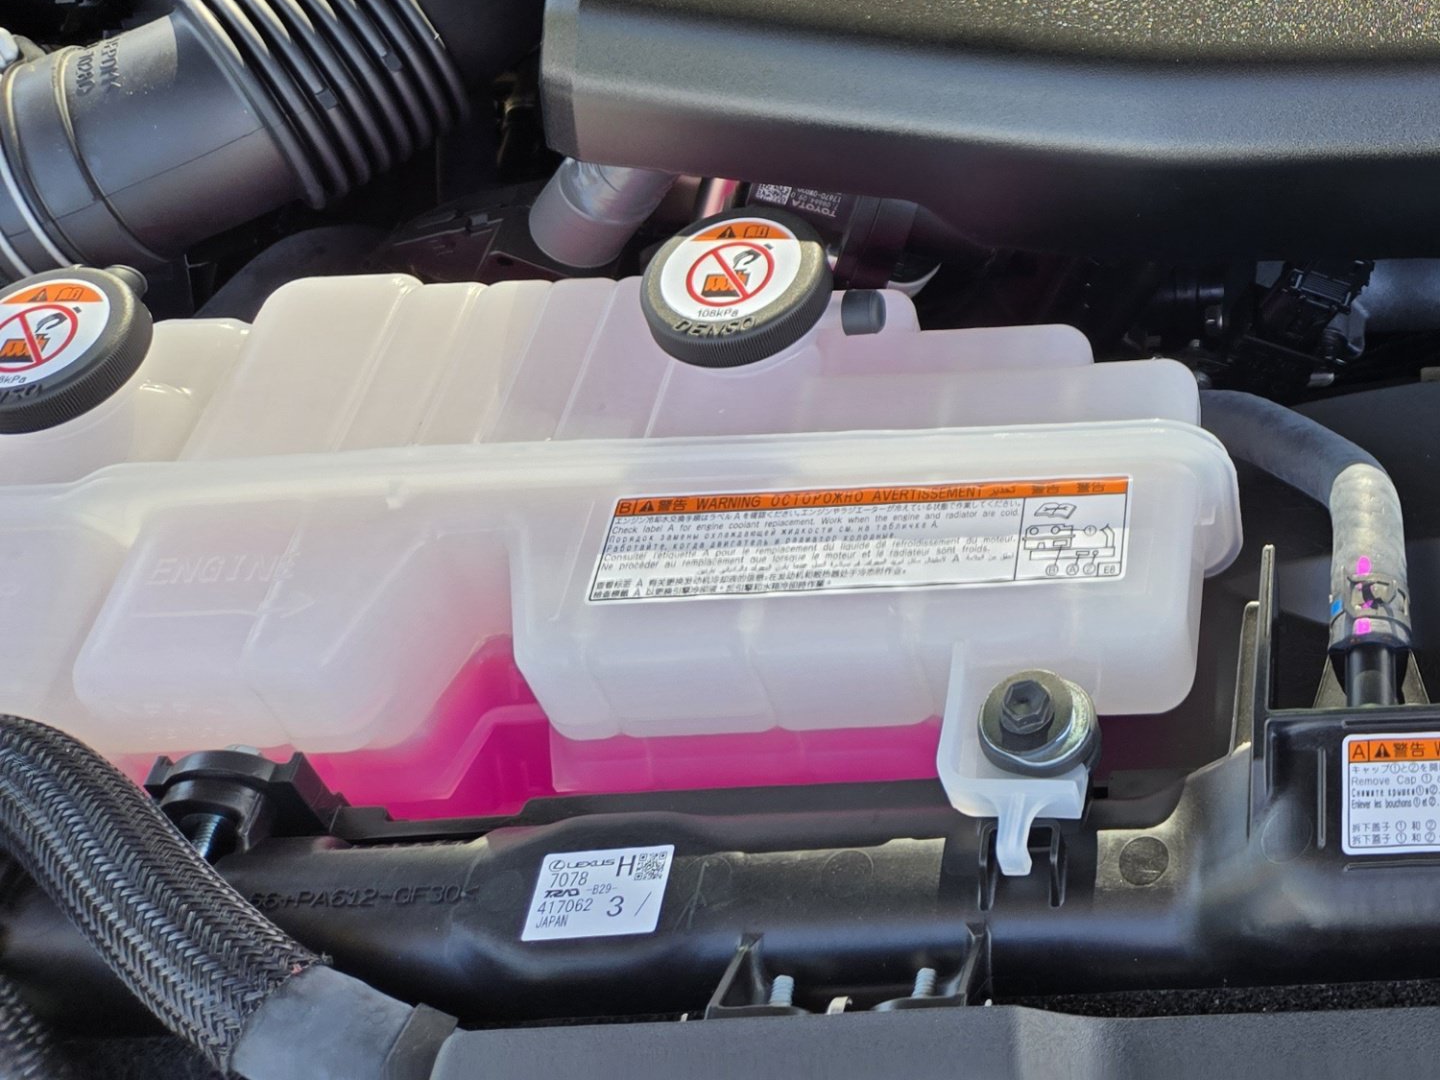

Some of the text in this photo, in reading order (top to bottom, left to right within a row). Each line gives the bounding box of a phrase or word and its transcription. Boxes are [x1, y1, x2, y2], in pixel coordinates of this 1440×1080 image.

[791, 198, 837, 218] TOYOTA
[697, 308, 739, 318] 108kPa
[672, 316, 755, 337] DENSO
[618, 501, 632, 513] B
[657, 499, 688, 512] 警告
[694, 495, 762, 510] WARNING
[770, 491, 864, 507] ОСТОРОЖНО
[871, 485, 981, 502] AVERTISSEMENT
[611, 526, 638, 534] Check
[642, 525, 663, 533] label
[695, 523, 724, 532] engine
[728, 521, 759, 529] coolant
[763, 518, 815, 528] replacement.
[821, 517, 842, 525] Work
[892, 514, 920, 523] engine
[945, 511, 977, 519] radiator
[144, 551, 300, 586] ENGINE
[1352, 744, 1365, 759] A
[1393, 742, 1424, 757] 警告
[1351, 775, 1389, 785] Remove
[1397, 774, 1416, 785] Cap
[567, 855, 636, 877] LEXUS H
[550, 872, 589, 888] 7078
[537, 895, 624, 917] 417062 3
[535, 914, 568, 929] JAPAN
